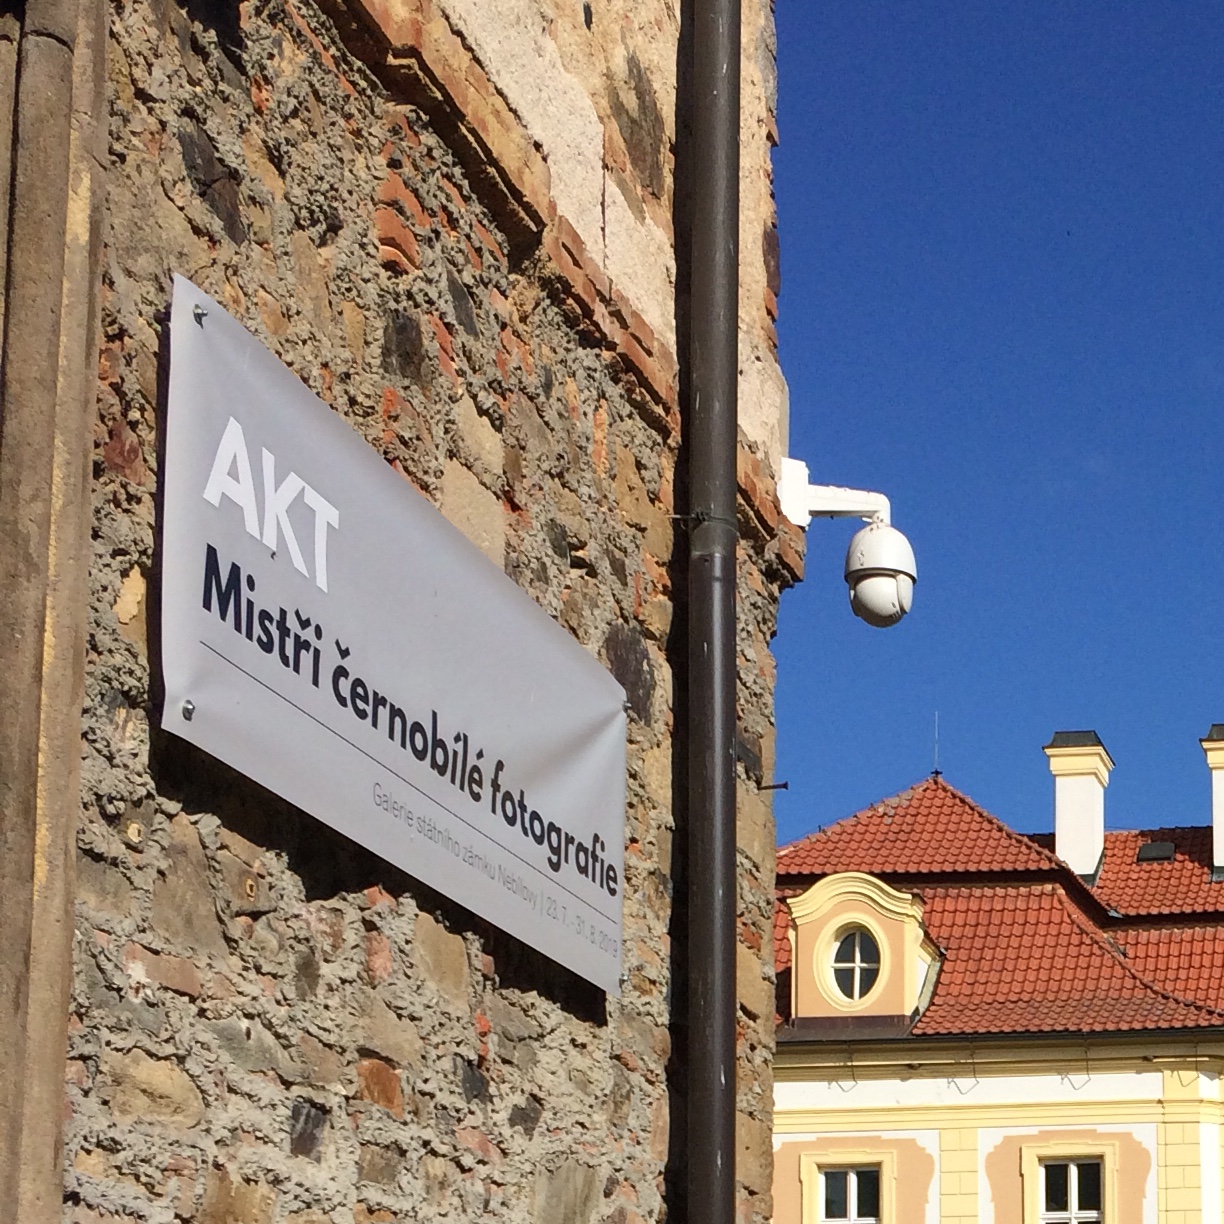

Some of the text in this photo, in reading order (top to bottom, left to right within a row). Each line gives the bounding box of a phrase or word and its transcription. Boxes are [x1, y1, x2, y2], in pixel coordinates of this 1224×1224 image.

[203, 416, 339, 593] AKT
[202, 542, 619, 897] Mistři černobílé fotografie
[373, 782, 414, 827] Galerie
[416, 815, 460, 857] státního
[462, 845, 496, 880] zámku
